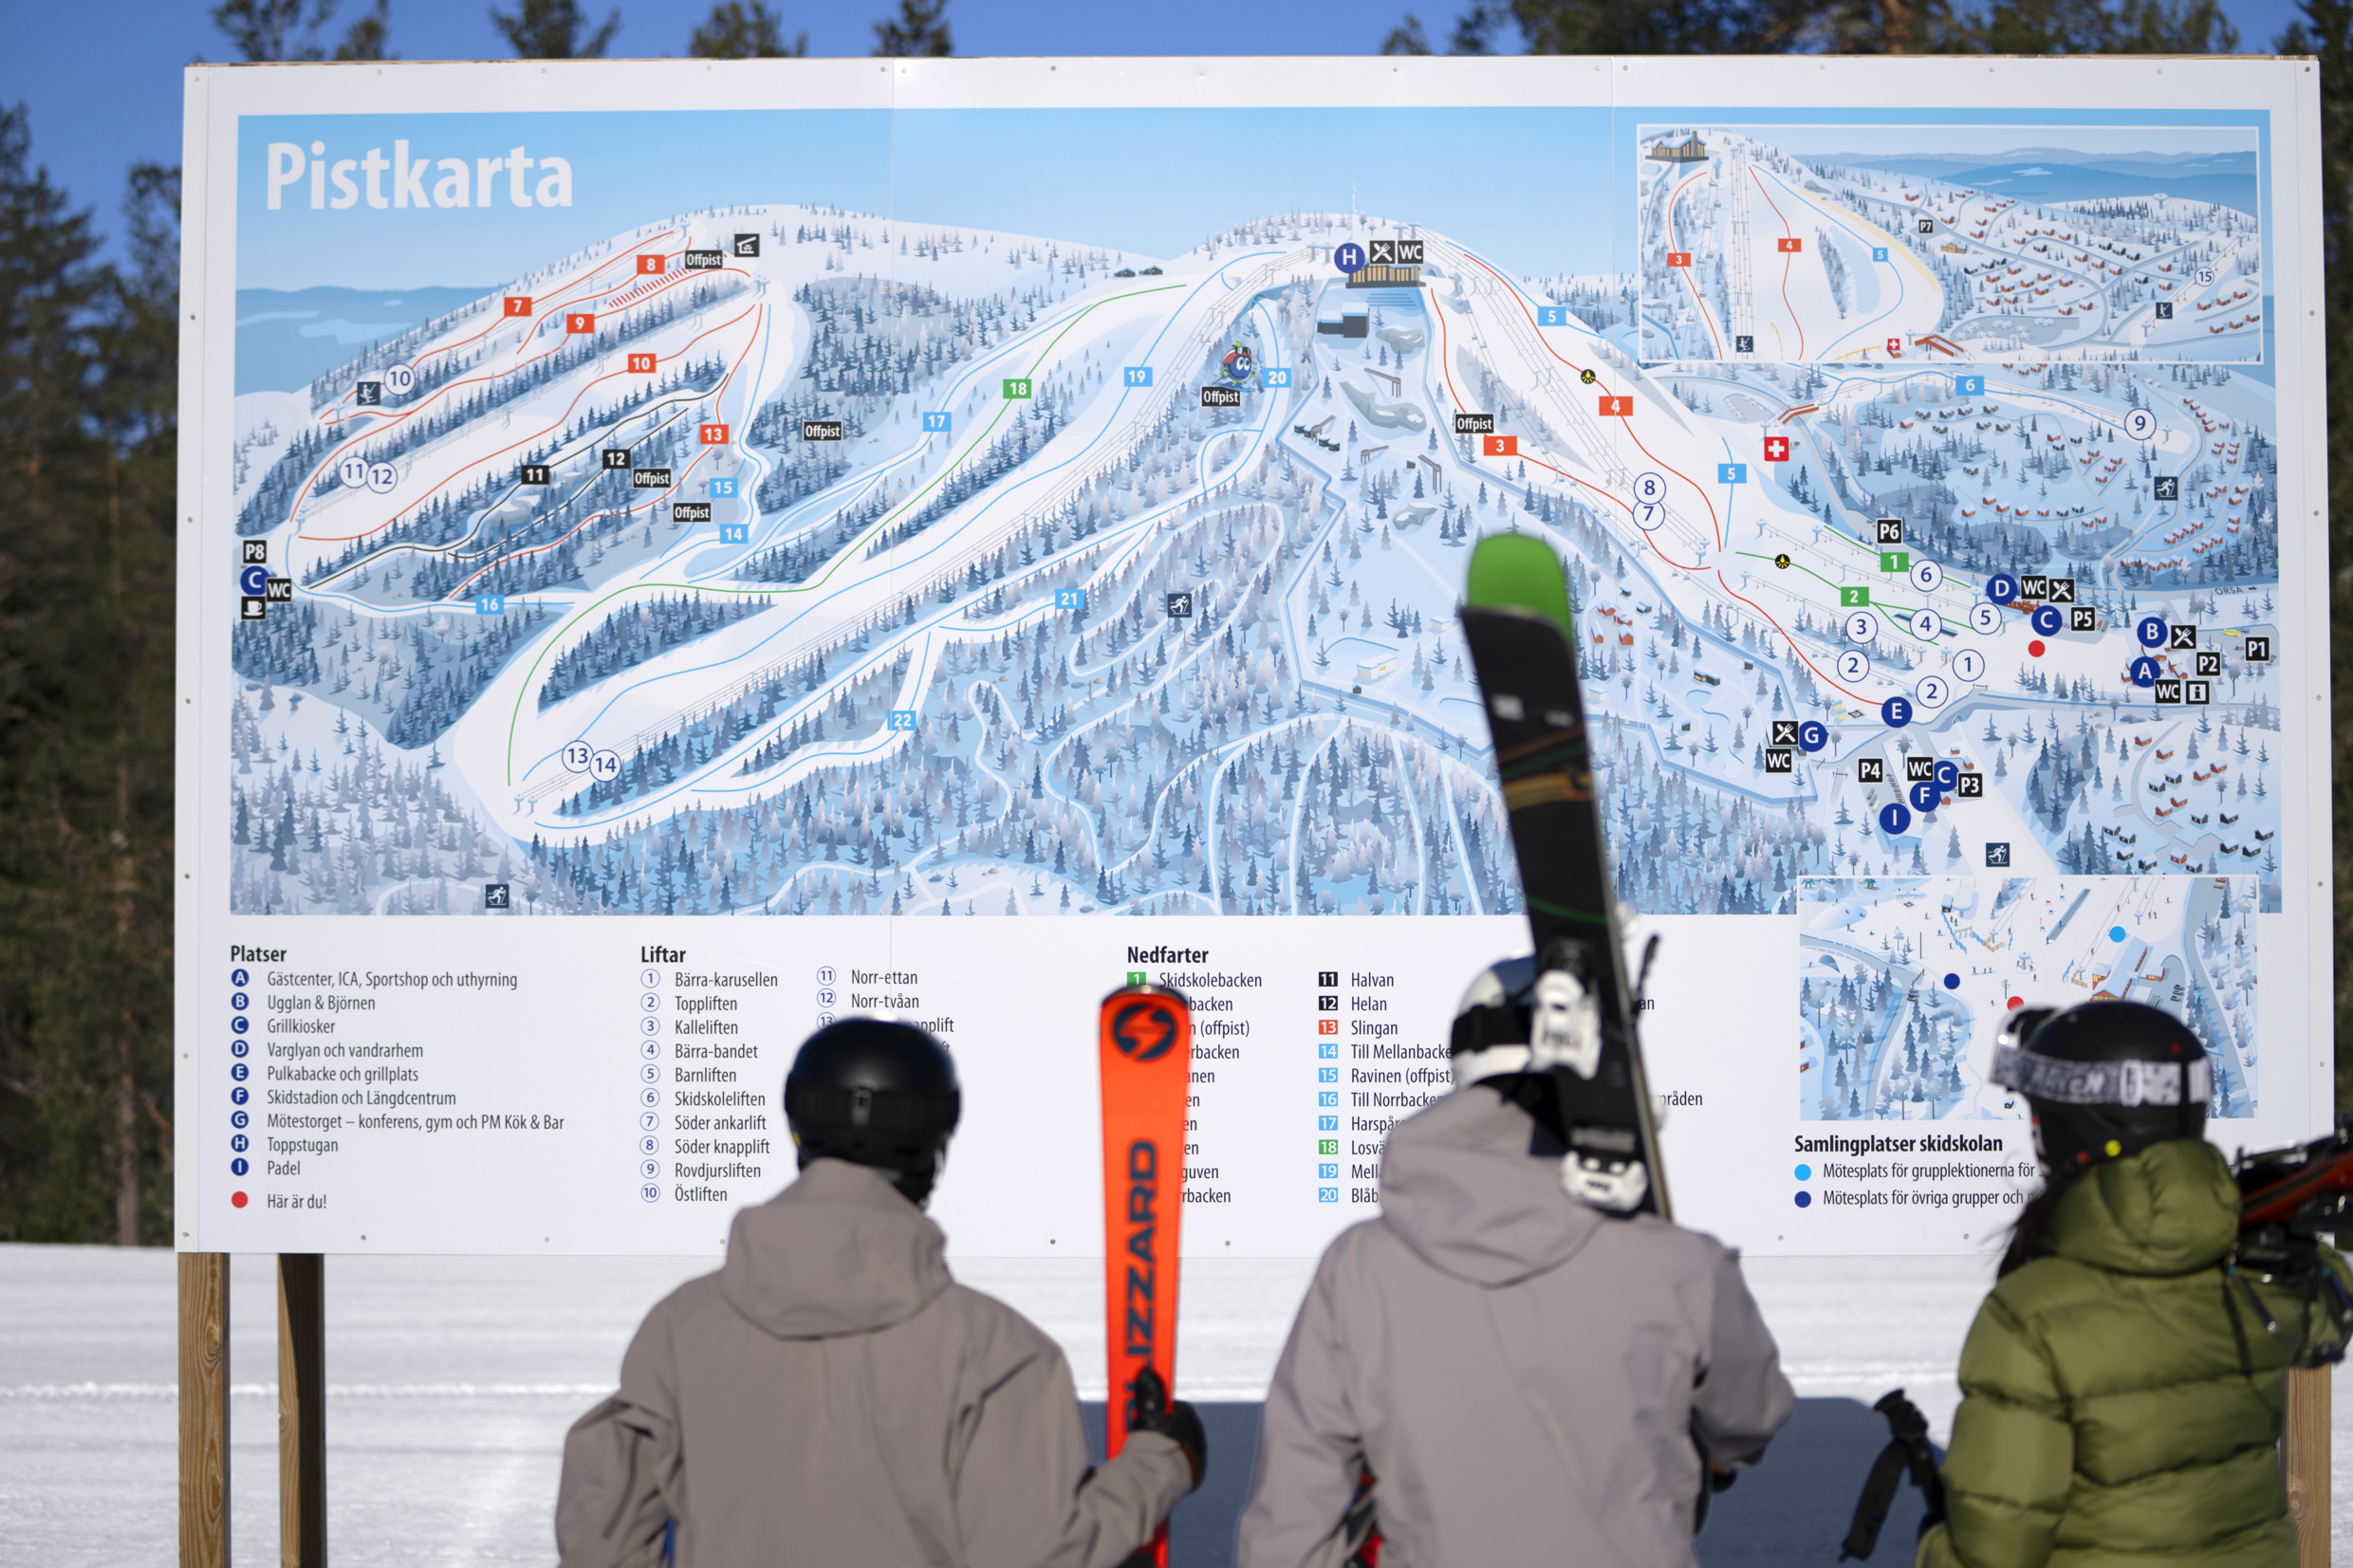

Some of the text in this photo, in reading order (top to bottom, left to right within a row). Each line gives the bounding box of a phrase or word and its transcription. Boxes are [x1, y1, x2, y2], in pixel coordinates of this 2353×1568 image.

[267, 139, 573, 210] Pistkarta
[1399, 245, 1421, 259] WC
[687, 253, 721, 267] Offpist
[1204, 390, 1239, 405] Offpist
[806, 425, 840, 439] Offpist
[1457, 417, 1491, 432] Offpist
[635, 472, 669, 487] Offpist
[675, 507, 709, 521] Offpist
[269, 583, 289, 598] WC
[2023, 581, 2045, 595] WC
[2215, 586, 2243, 595] ORSA
[2158, 684, 2178, 698] WC
[1768, 753, 1789, 767] WC
[1909, 762, 1931, 776] WC
[232, 945, 287, 962] Platser
[641, 946, 686, 963] Liftar
[1128, 946, 1209, 963] Nedfarter
[268, 971, 335, 987] Gästcenter,
[339, 971, 361, 987] ICA,
[366, 971, 428, 989] Sportshop
[432, 971, 453, 987] och
[457, 971, 517, 990] uthyrning
[676, 972, 777, 987] Bärra-karusellen
[852, 969, 917, 984] Norr-ettan
[1159, 973, 1263, 988] Skidskolebacken
[1352, 972, 1394, 987] Halvan
[269, 995, 310, 1013] Ugglan
[315, 995, 324, 1009] &
[328, 995, 375, 1013] Björnen
[676, 996, 737, 1014] Toppliften
[852, 993, 918, 1008] Norr-tvåan
[1352, 996, 1386, 1011] Helan
[268, 1019, 335, 1033] Grillkiosker
[676, 1020, 737, 1034] Kalleliften
[1201, 1020, 1249, 1038] (offpist)
[1352, 1020, 1398, 1039] Slingan
[268, 1042, 320, 1061] Varglyan
[324, 1042, 344, 1057] och
[349, 1042, 423, 1058] vandrarhem
[676, 1043, 758, 1058] Bärra-bandet
[1351, 1044, 1368, 1059] Till
[1372, 1044, 1453, 1060] Mellanbacke
[269, 1066, 336, 1080] Pulkabacke
[340, 1066, 361, 1080] och
[364, 1066, 418, 1085] grillplats
[676, 1067, 736, 1082] Barnliften
[1352, 1068, 1400, 1082] Ravinen
[1404, 1069, 1455, 1087] (offpist)
[268, 1090, 338, 1104] Skidstadion
[342, 1090, 362, 1104] och
[367, 1090, 455, 1109] Längdcentrum
[676, 1091, 765, 1106] Skidskoleliften
[1351, 1092, 1368, 1106] Till
[268, 1114, 342, 1132] Mötestorget
[360, 1114, 421, 1131] konferens,
[426, 1118, 452, 1133] gym
[456, 1115, 477, 1129] och
[482, 1115, 500, 1129] PM
[506, 1115, 527, 1129] Kök
[530, 1115, 540, 1129] &
[545, 1115, 565, 1129] Bar
[676, 1116, 711, 1130] Söder
[714, 1115, 767, 1130] ankarlift
[268, 1137, 338, 1155] Toppstugan
[676, 1139, 711, 1153] Söder
[714, 1139, 769, 1157] knapplift
[1795, 1134, 2002, 1156] Samlingplatser skidskolan
[268, 1160, 300, 1175] Padel
[676, 1163, 760, 1181] Rovdjursliften
[1824, 1163, 1888, 1181] Mötesplats
[1892, 1163, 1908, 1177] för
[1912, 1163, 2014, 1181] grupplektionerna
[2018, 1162, 2035, 1176] för
[268, 1194, 326, 1208] Här är du!
[676, 1187, 727, 1201] Östliften
[1824, 1190, 1888, 1208] Mötesplats
[1892, 1190, 1908, 1205] för
[1912, 1190, 1948, 1208] övriga
[1953, 1193, 1999, 1208] grupper
[2003, 1190, 2023, 1204] och
